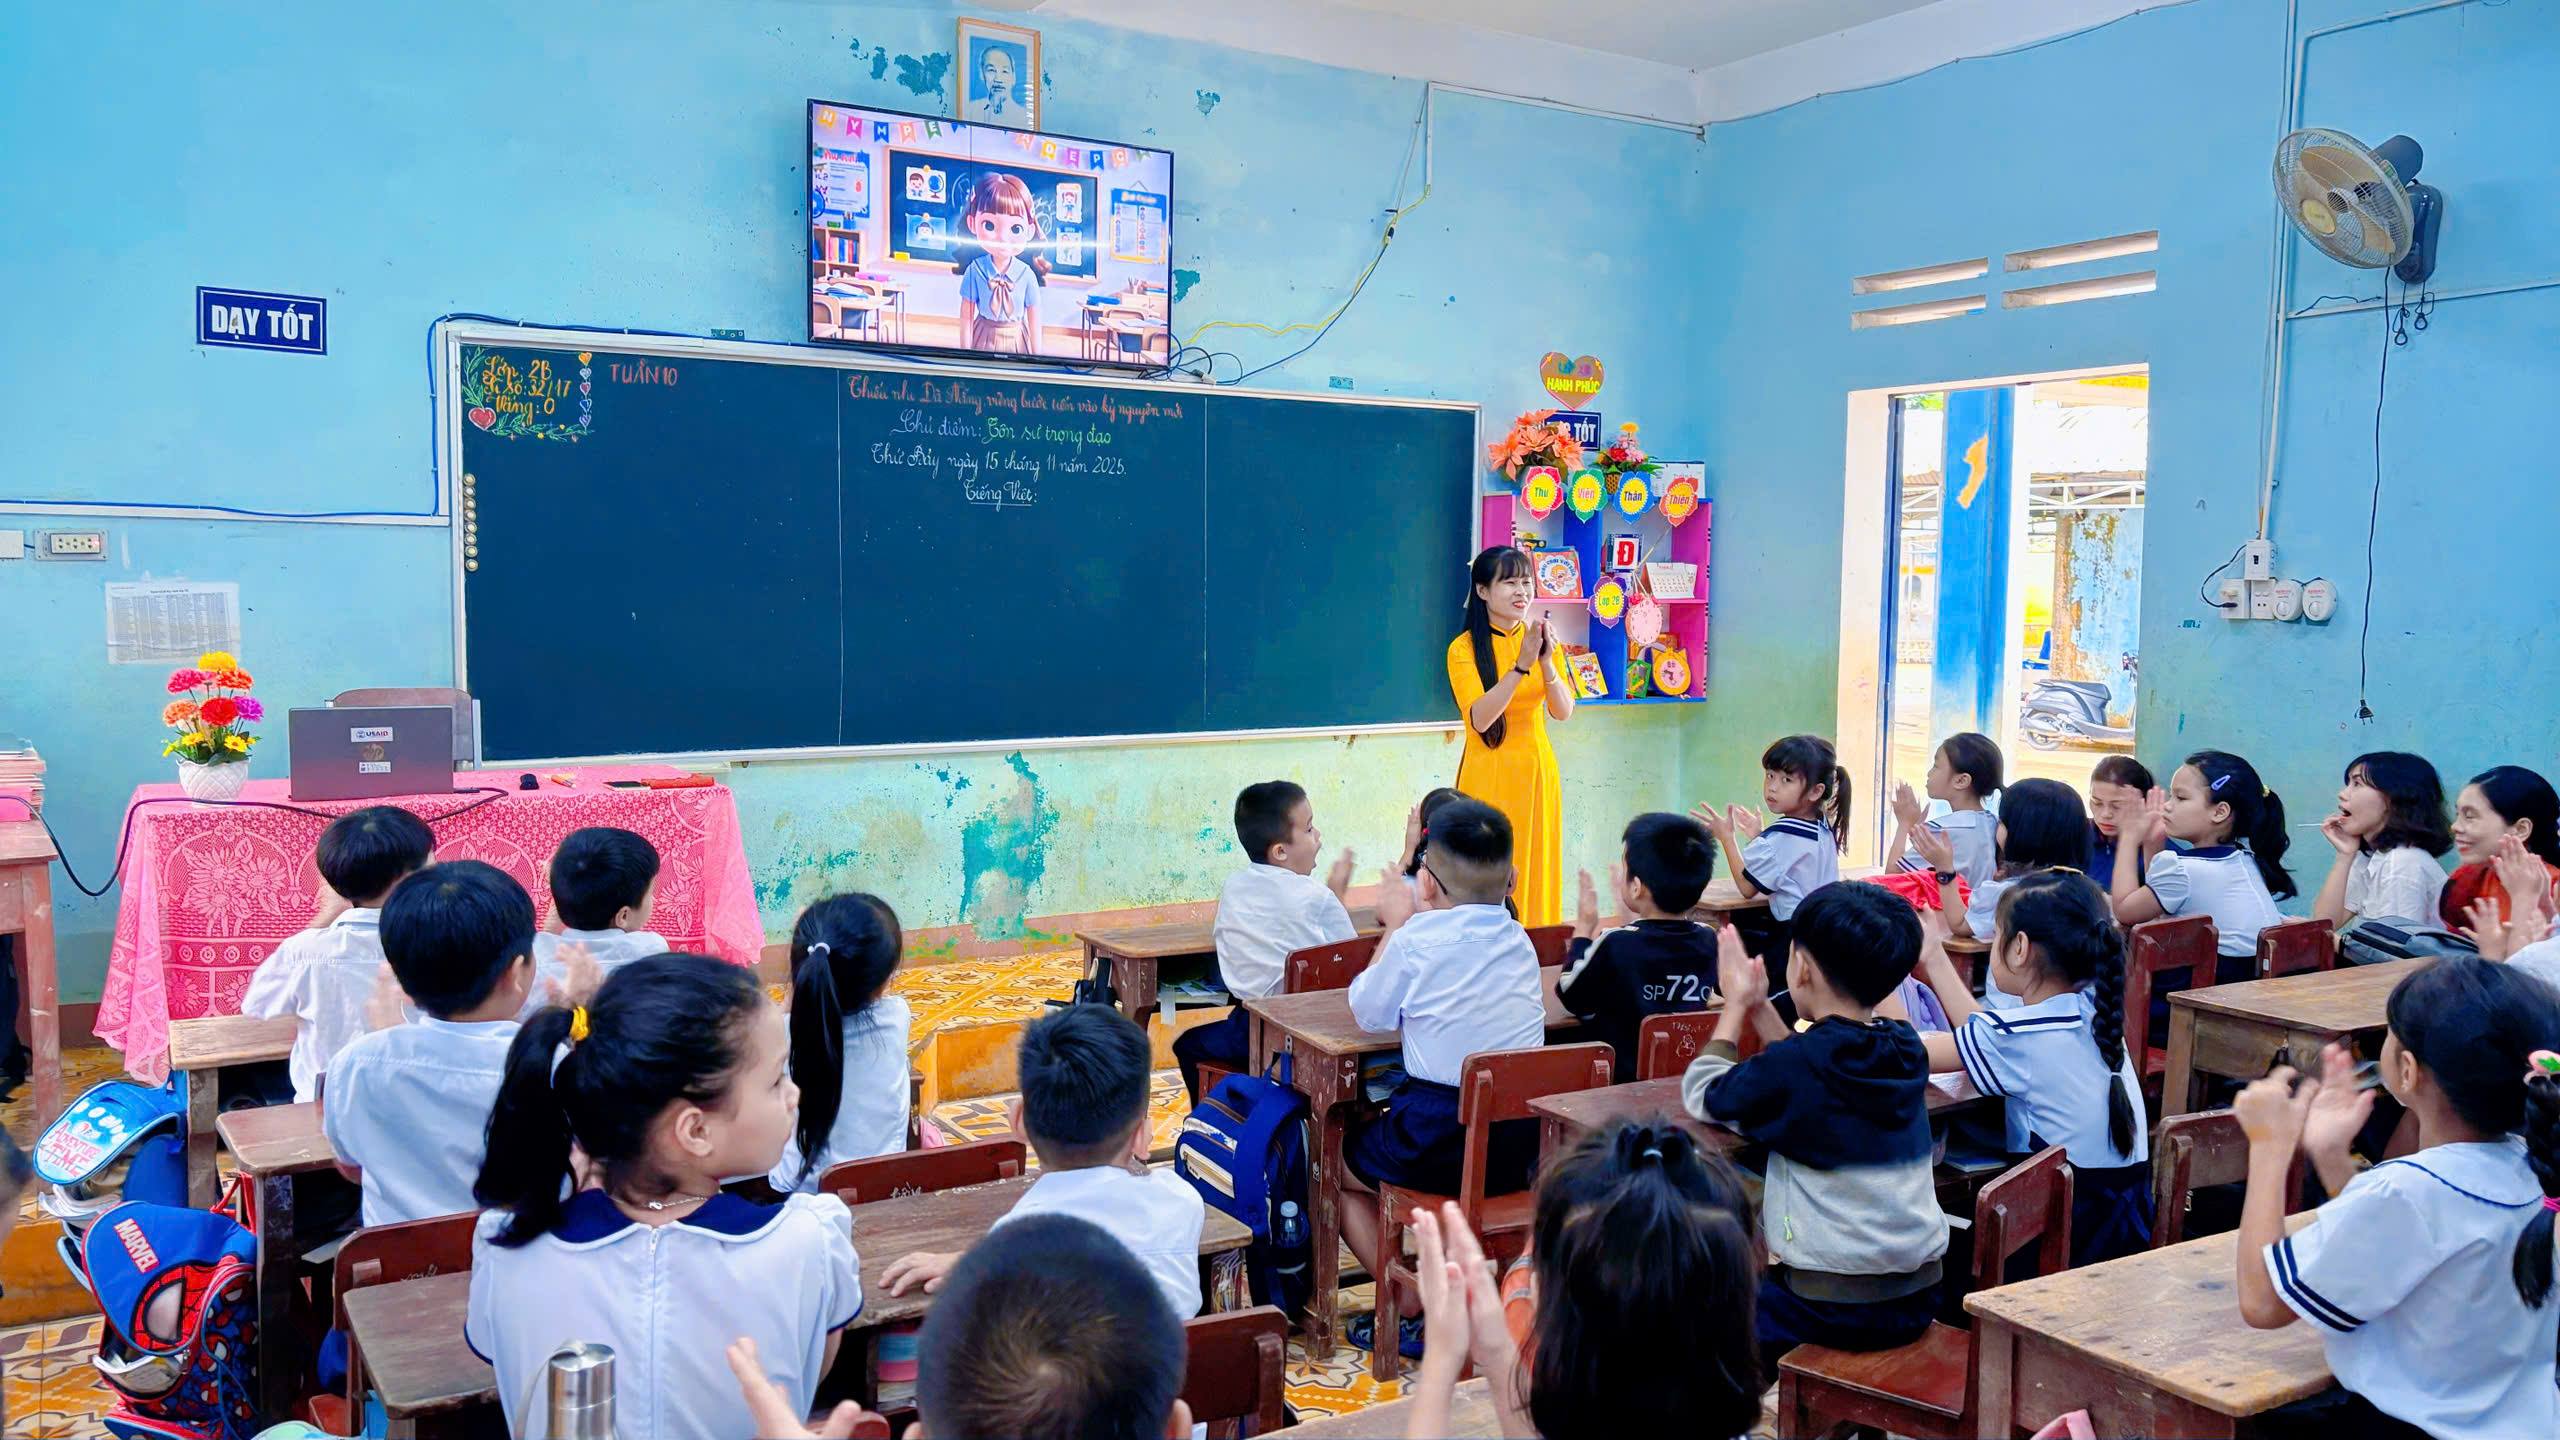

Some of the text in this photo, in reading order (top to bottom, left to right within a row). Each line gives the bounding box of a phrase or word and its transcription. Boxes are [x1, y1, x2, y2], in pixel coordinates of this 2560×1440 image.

[211, 303, 314, 341] DẠY TỐT
[529, 360, 552, 380] 2B
[608, 358, 678, 386] TUẦN 10
[1546, 376, 1600, 393] HẠNH PHÚC
[528, 379, 571, 397] 32/17
[1021, 388, 1048, 410] bước
[1078, 400, 1099, 413] vào
[1118, 402, 1160, 424] nguyên
[890, 408, 934, 436] Chủ
[938, 415, 982, 437] điểm:
[982, 417, 1015, 444] Tôn
[1045, 426, 1083, 454] trọng
[1086, 423, 1112, 447] đạo
[1574, 417, 1597, 442] TỐT
[871, 442, 905, 464] Thứ
[907, 445, 939, 479] Bảy
[947, 452, 979, 480] ngày
[985, 451, 1000, 470] 15
[1004, 449, 1040, 483] tháng
[1046, 453, 1056, 471] 11
[1059, 457, 1088, 473] năm
[963, 479, 1002, 512] Tiếng
[1617, 541, 1635, 566] Đ
[48, 1121, 102, 1158] ADVENTURE
[113, 1218, 159, 1273] MARVEL
